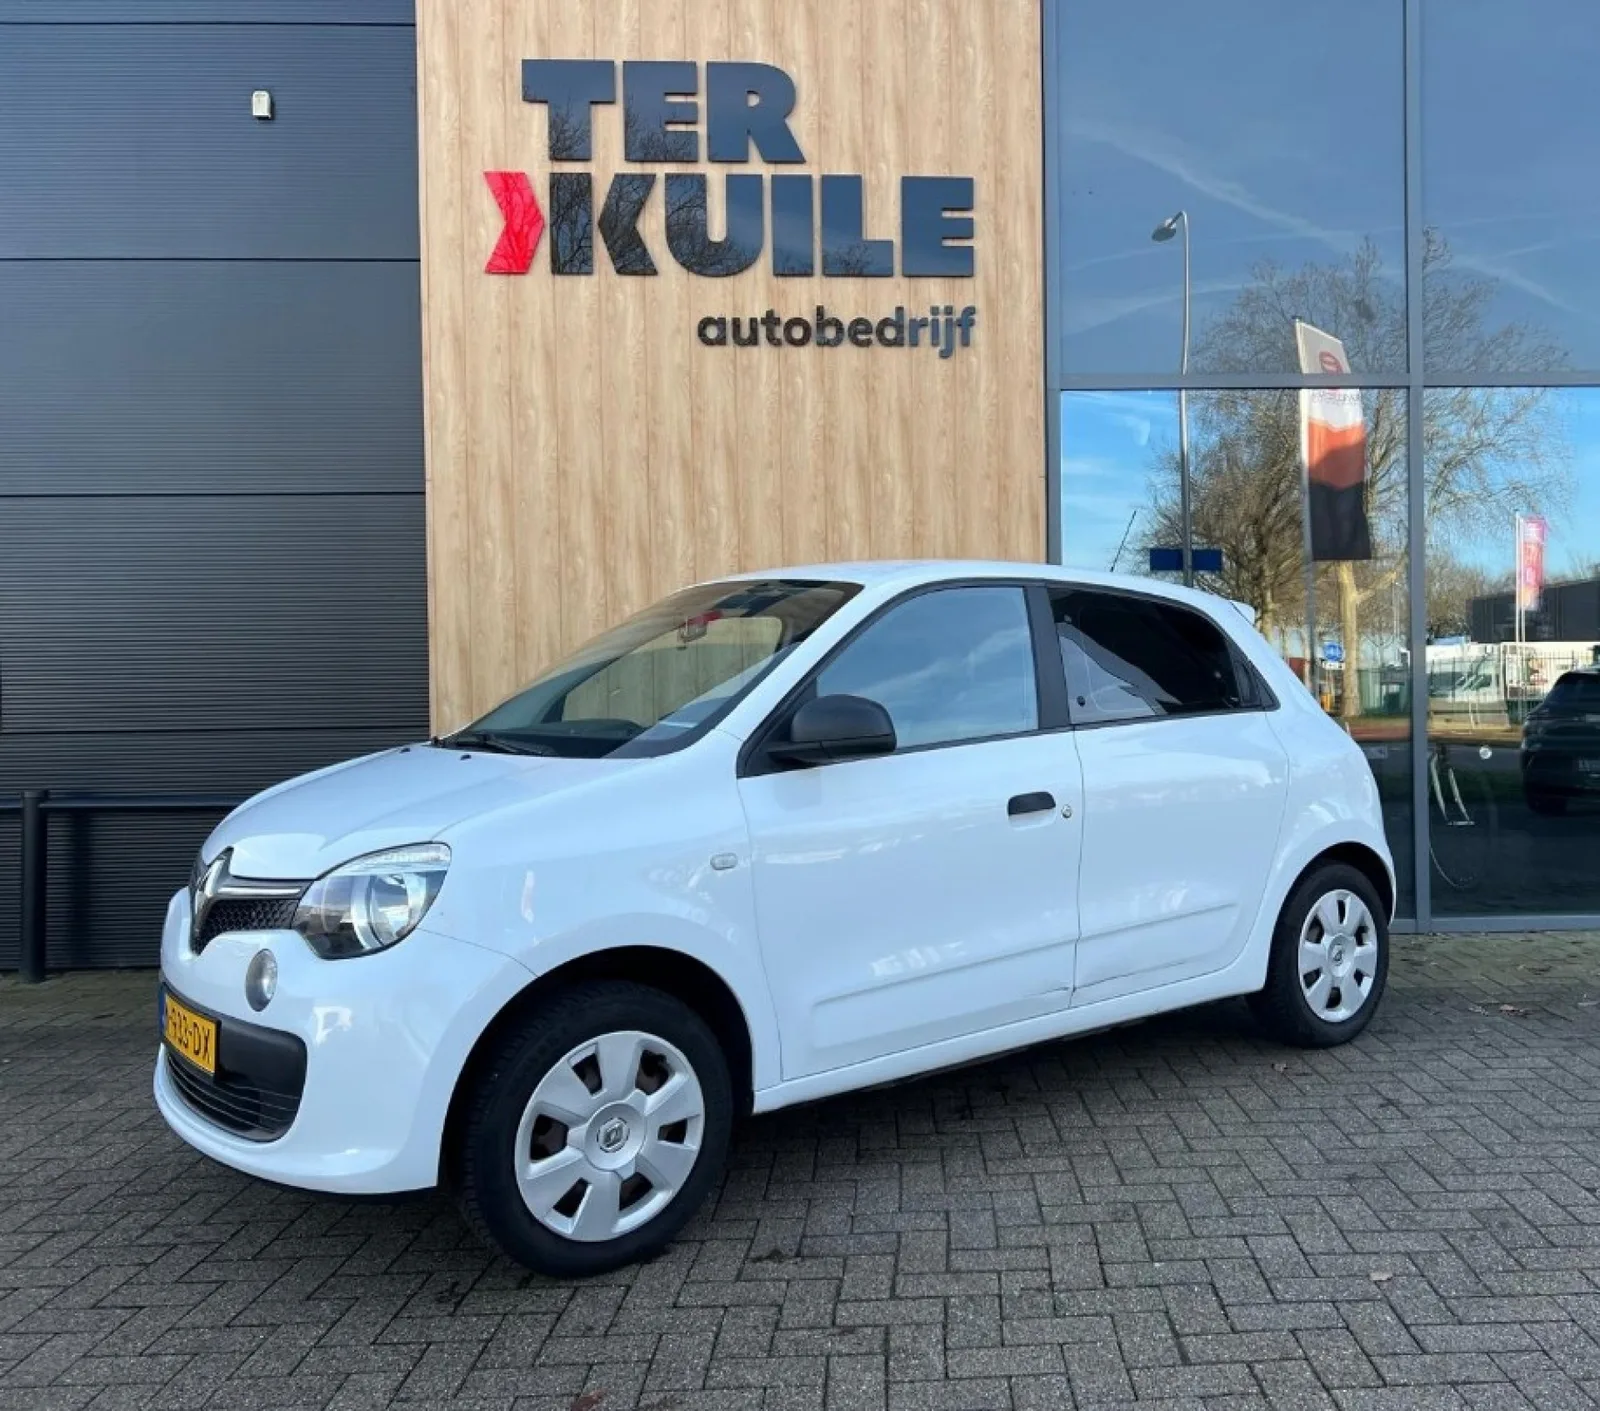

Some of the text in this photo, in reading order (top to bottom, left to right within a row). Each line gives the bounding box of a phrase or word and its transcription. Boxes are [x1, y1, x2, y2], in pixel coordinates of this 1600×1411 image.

[521, 59, 806, 164] TER
[548, 172, 974, 277] KUILE
[697, 305, 976, 358] autobedrijf
